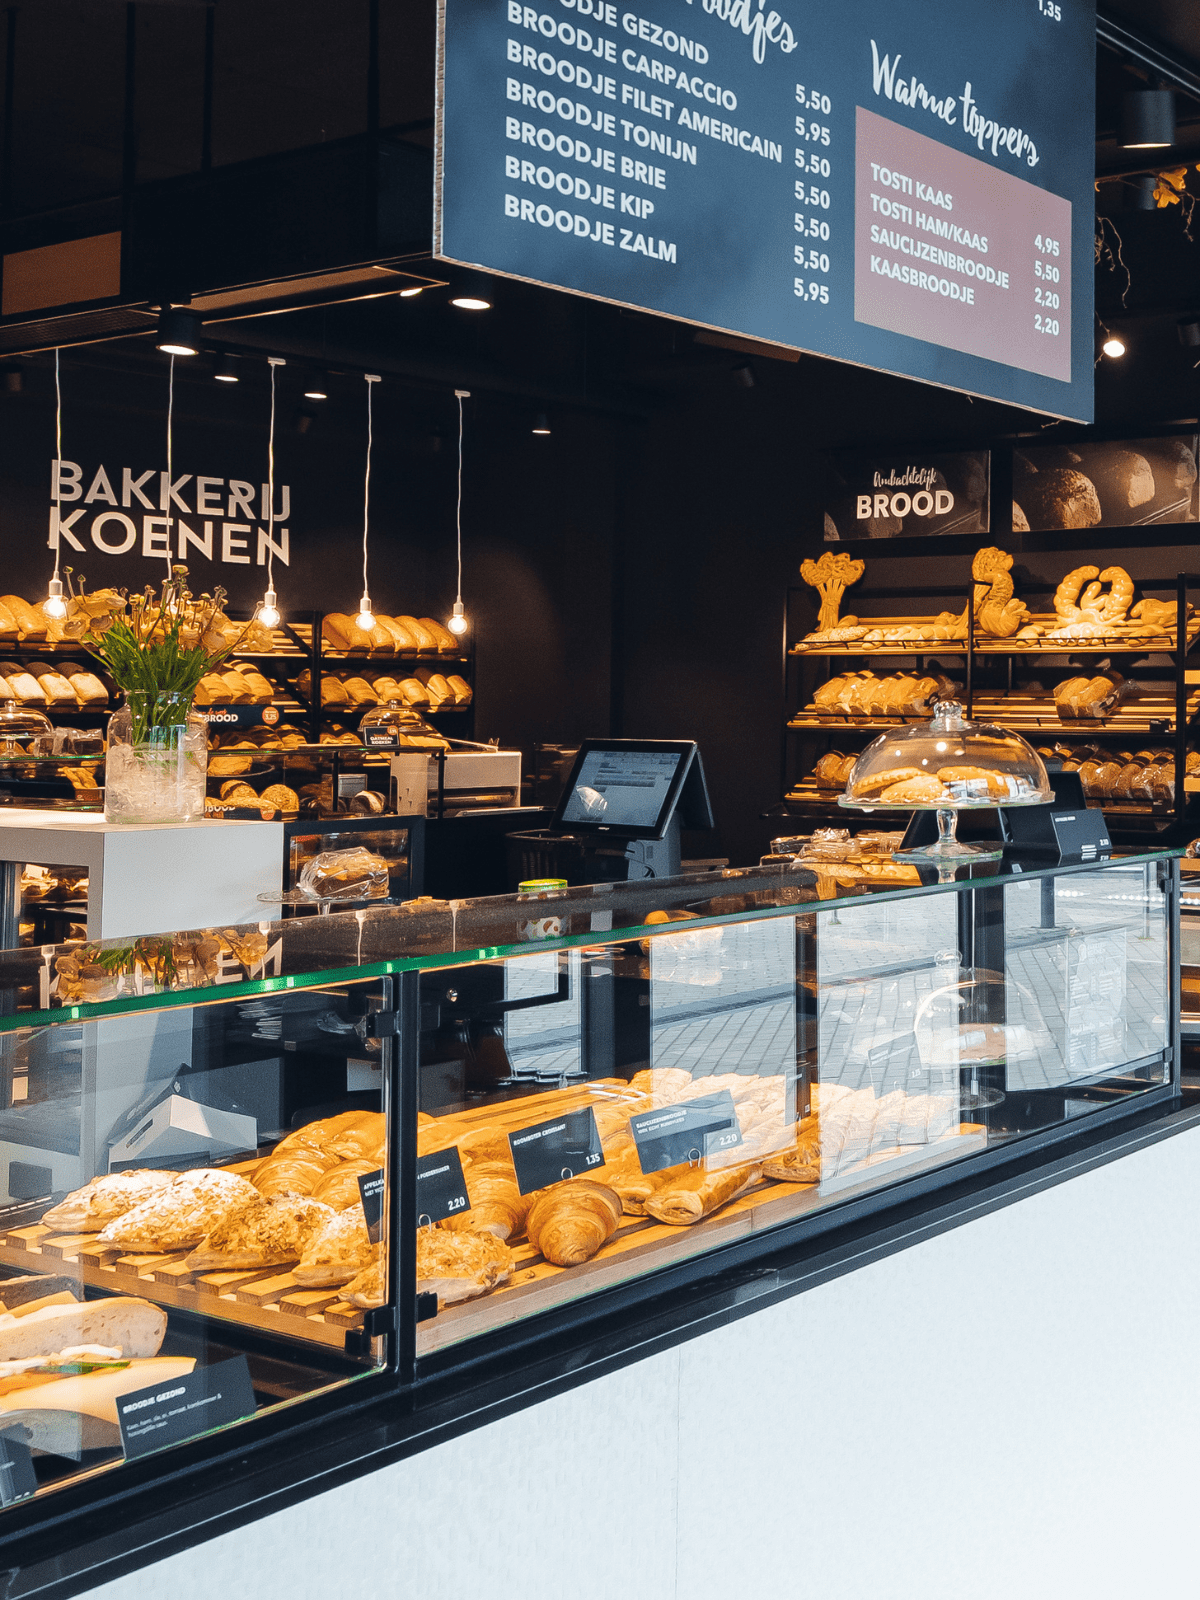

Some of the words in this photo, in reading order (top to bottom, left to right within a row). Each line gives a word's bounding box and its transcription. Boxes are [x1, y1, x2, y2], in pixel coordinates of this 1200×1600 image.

[507, 39, 617, 100] BROODJE
[622, 84, 674, 121] FILET
[677, 107, 782, 163] AMERICAIN
[794, 148, 830, 177] 5,50
[508, 0, 617, 63] BROODJE
[622, 49, 737, 111] CARPACCIO
[794, 116, 830, 146] 5,95
[622, 13, 709, 64] GEZOND
[795, 84, 831, 115] 5,50
[870, 39, 957, 125] Warme
[959, 81, 1039, 167] toppers
[506, 77, 616, 136] BROODJE
[621, 119, 697, 165] TONIJN
[794, 180, 830, 209] 5,50
[506, 116, 615, 173] BROODJE
[621, 156, 666, 190] BRIE
[794, 213, 830, 241] 5,50
[504, 194, 614, 246] BROODJE
[619, 228, 677, 264] ZALM
[794, 277, 830, 304] 5,95
[505, 155, 615, 209] BROODJE
[620, 192, 654, 220] KIP
[794, 245, 830, 273] 5,50
[870, 162, 912, 195] TOSTI
[916, 181, 953, 211] KAAS
[1034, 234, 1060, 257] 4,95
[870, 193, 912, 224] TOSTI
[915, 211, 988, 253] HAM/KAAS
[1034, 260, 1060, 283] 5,50
[870, 224, 1009, 289] SAUCIJZENBROODJE
[1034, 287, 1060, 309] 2,20
[870, 255, 974, 305] KAASBROODJE
[1034, 313, 1060, 336] 2,20
[51, 459, 290, 522] BAKKERIJ
[856, 489, 954, 520] BROOD
[873, 465, 937, 491] Ambachtelijk
[48, 506, 290, 567] KOENEN
[447, 1196, 466, 1211] 2.20
